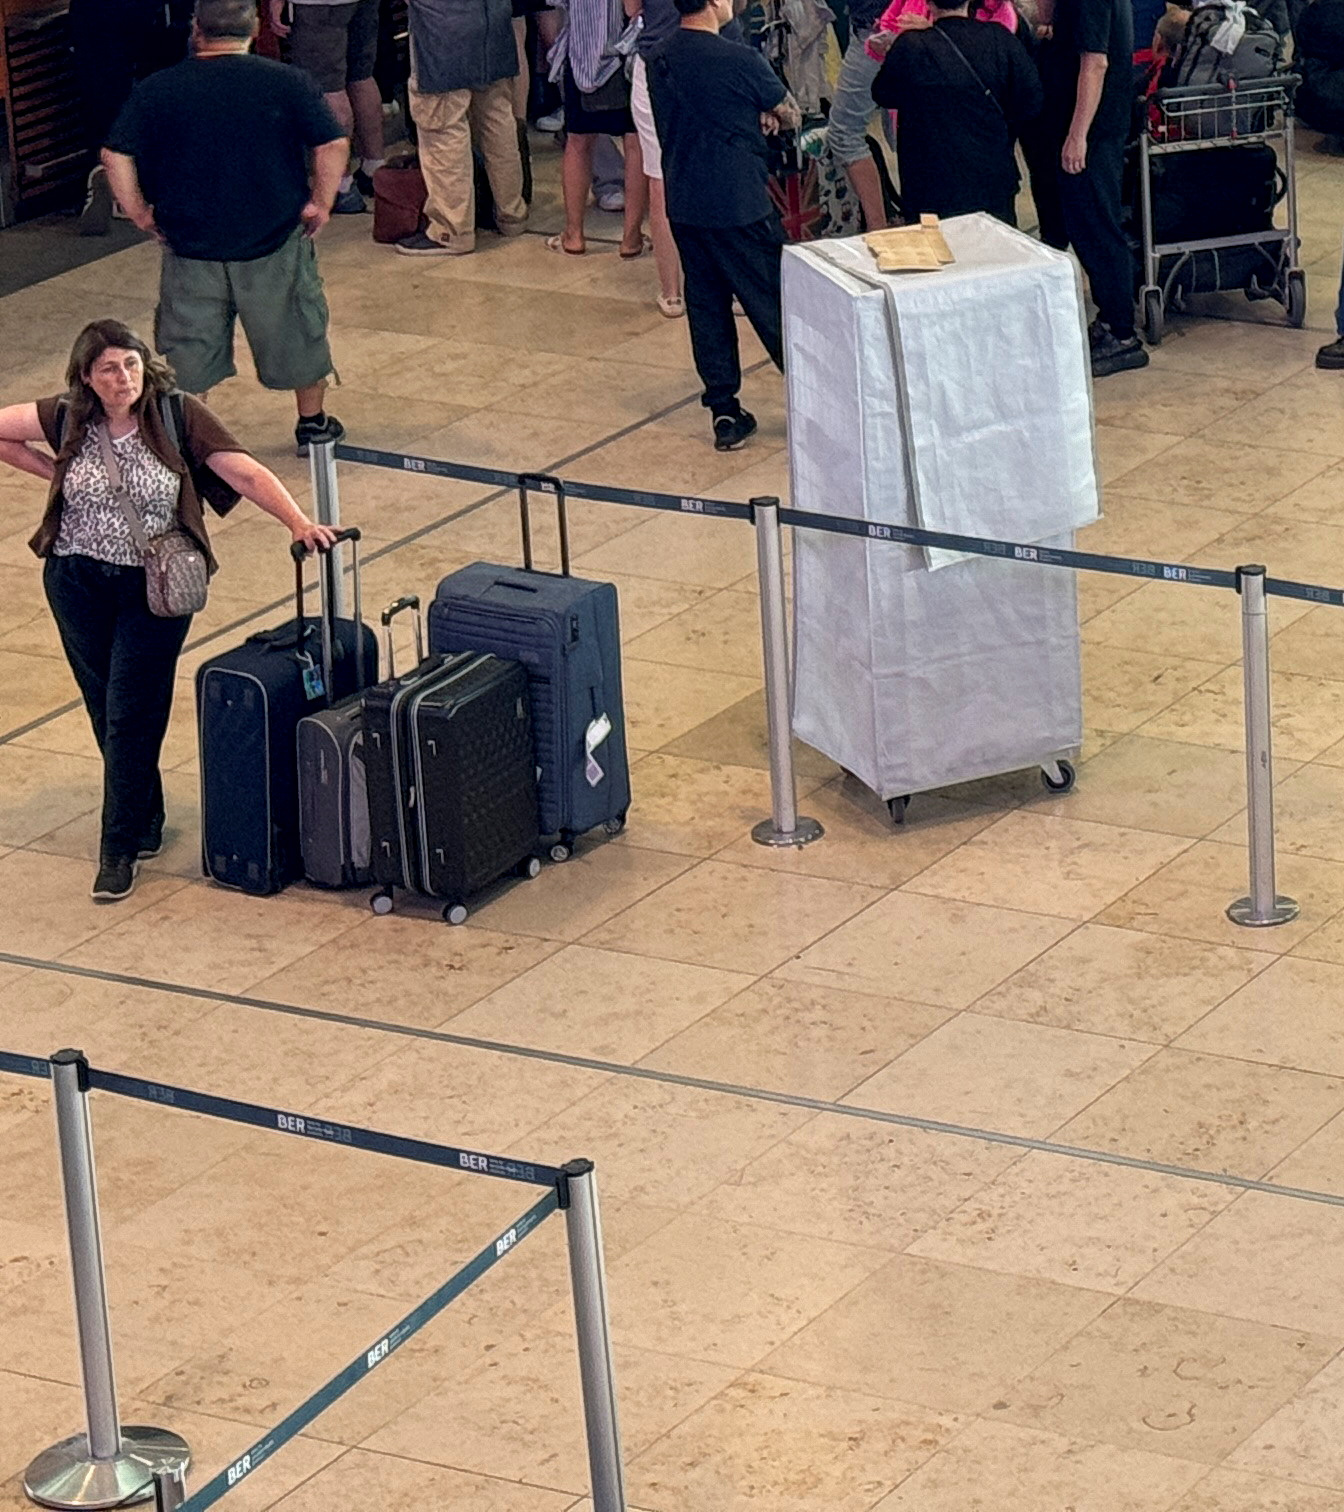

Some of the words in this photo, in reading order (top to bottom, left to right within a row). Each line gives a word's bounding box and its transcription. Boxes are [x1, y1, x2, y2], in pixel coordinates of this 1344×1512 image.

[680, 498, 704, 513] BER
[868, 524, 892, 539] BER
[1014, 544, 1038, 561] BER
[1163, 566, 1188, 581] BER
[277, 1114, 305, 1134] BER
[459, 1152, 488, 1172] BER
[496, 1228, 518, 1257] BER
[367, 1338, 389, 1369] BER
[227, 1454, 252, 1486] BER
